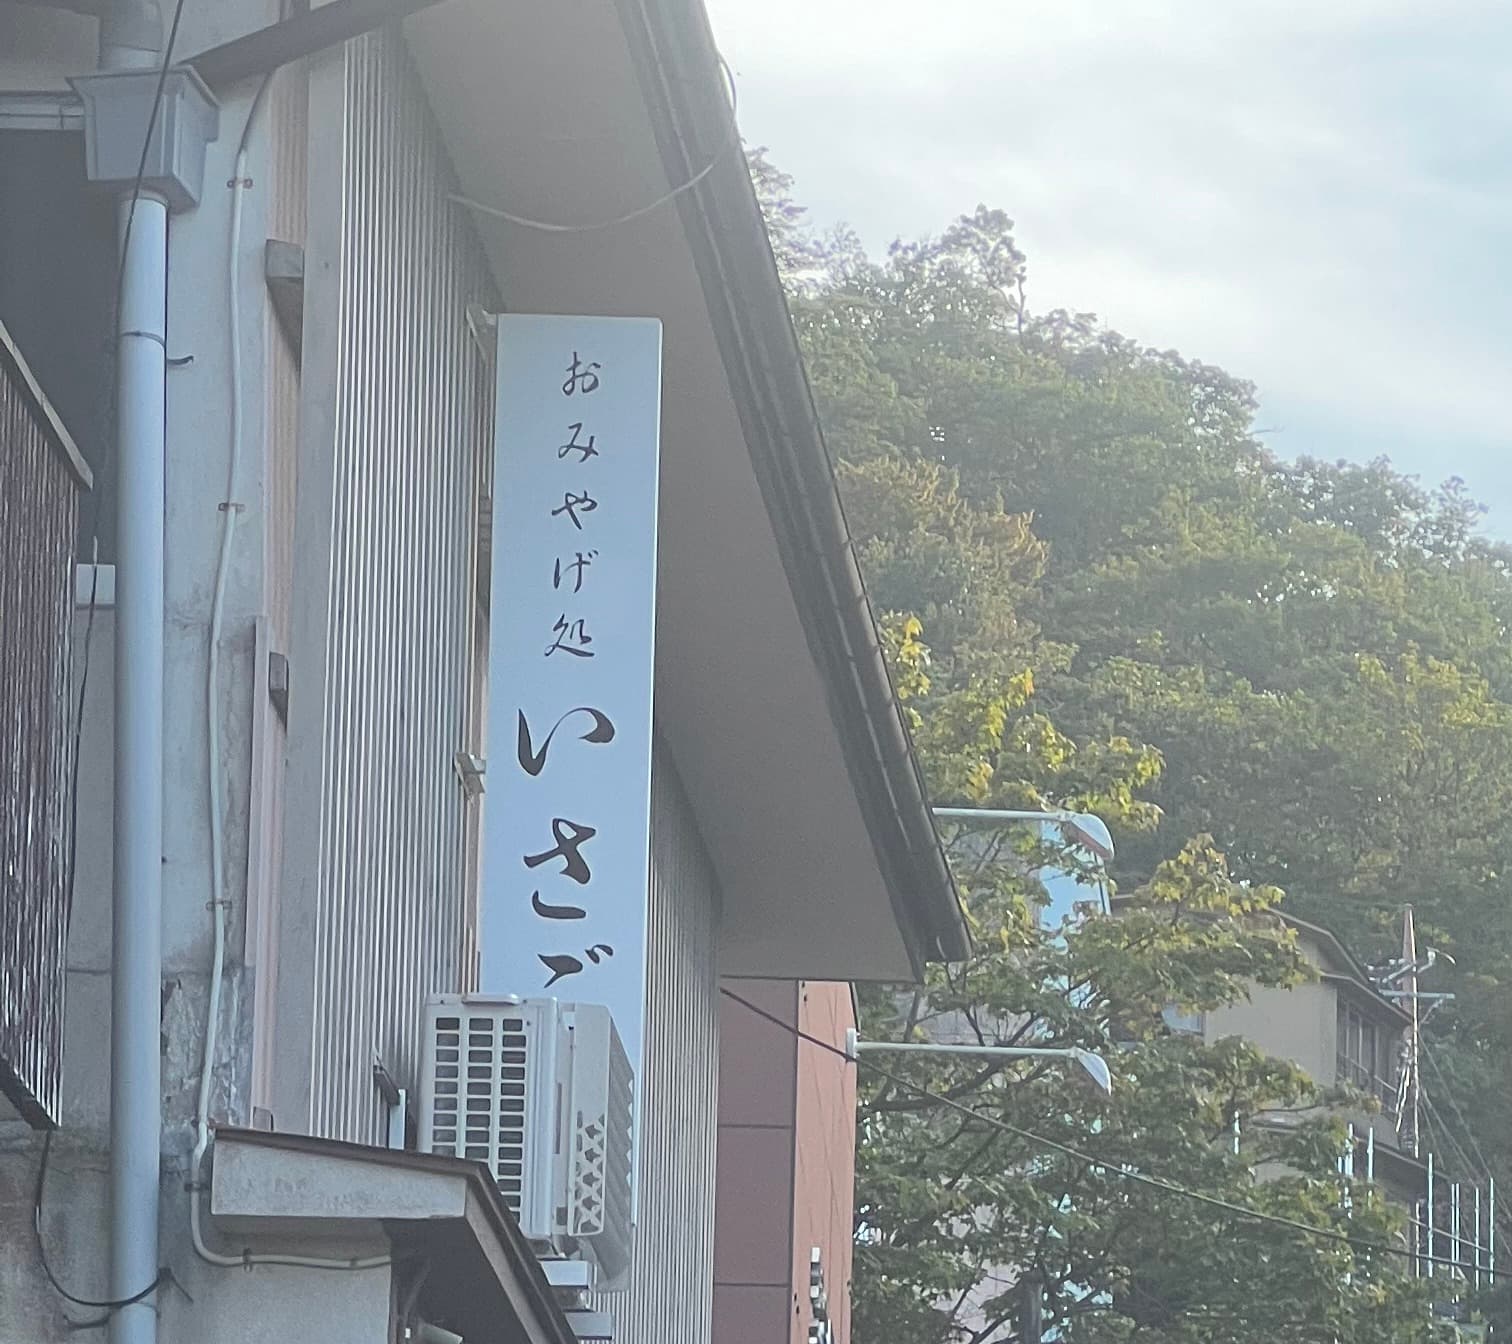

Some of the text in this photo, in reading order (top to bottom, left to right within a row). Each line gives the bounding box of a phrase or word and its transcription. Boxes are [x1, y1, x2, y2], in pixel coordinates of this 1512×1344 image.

[545, 351, 601, 658] おみやげ処
